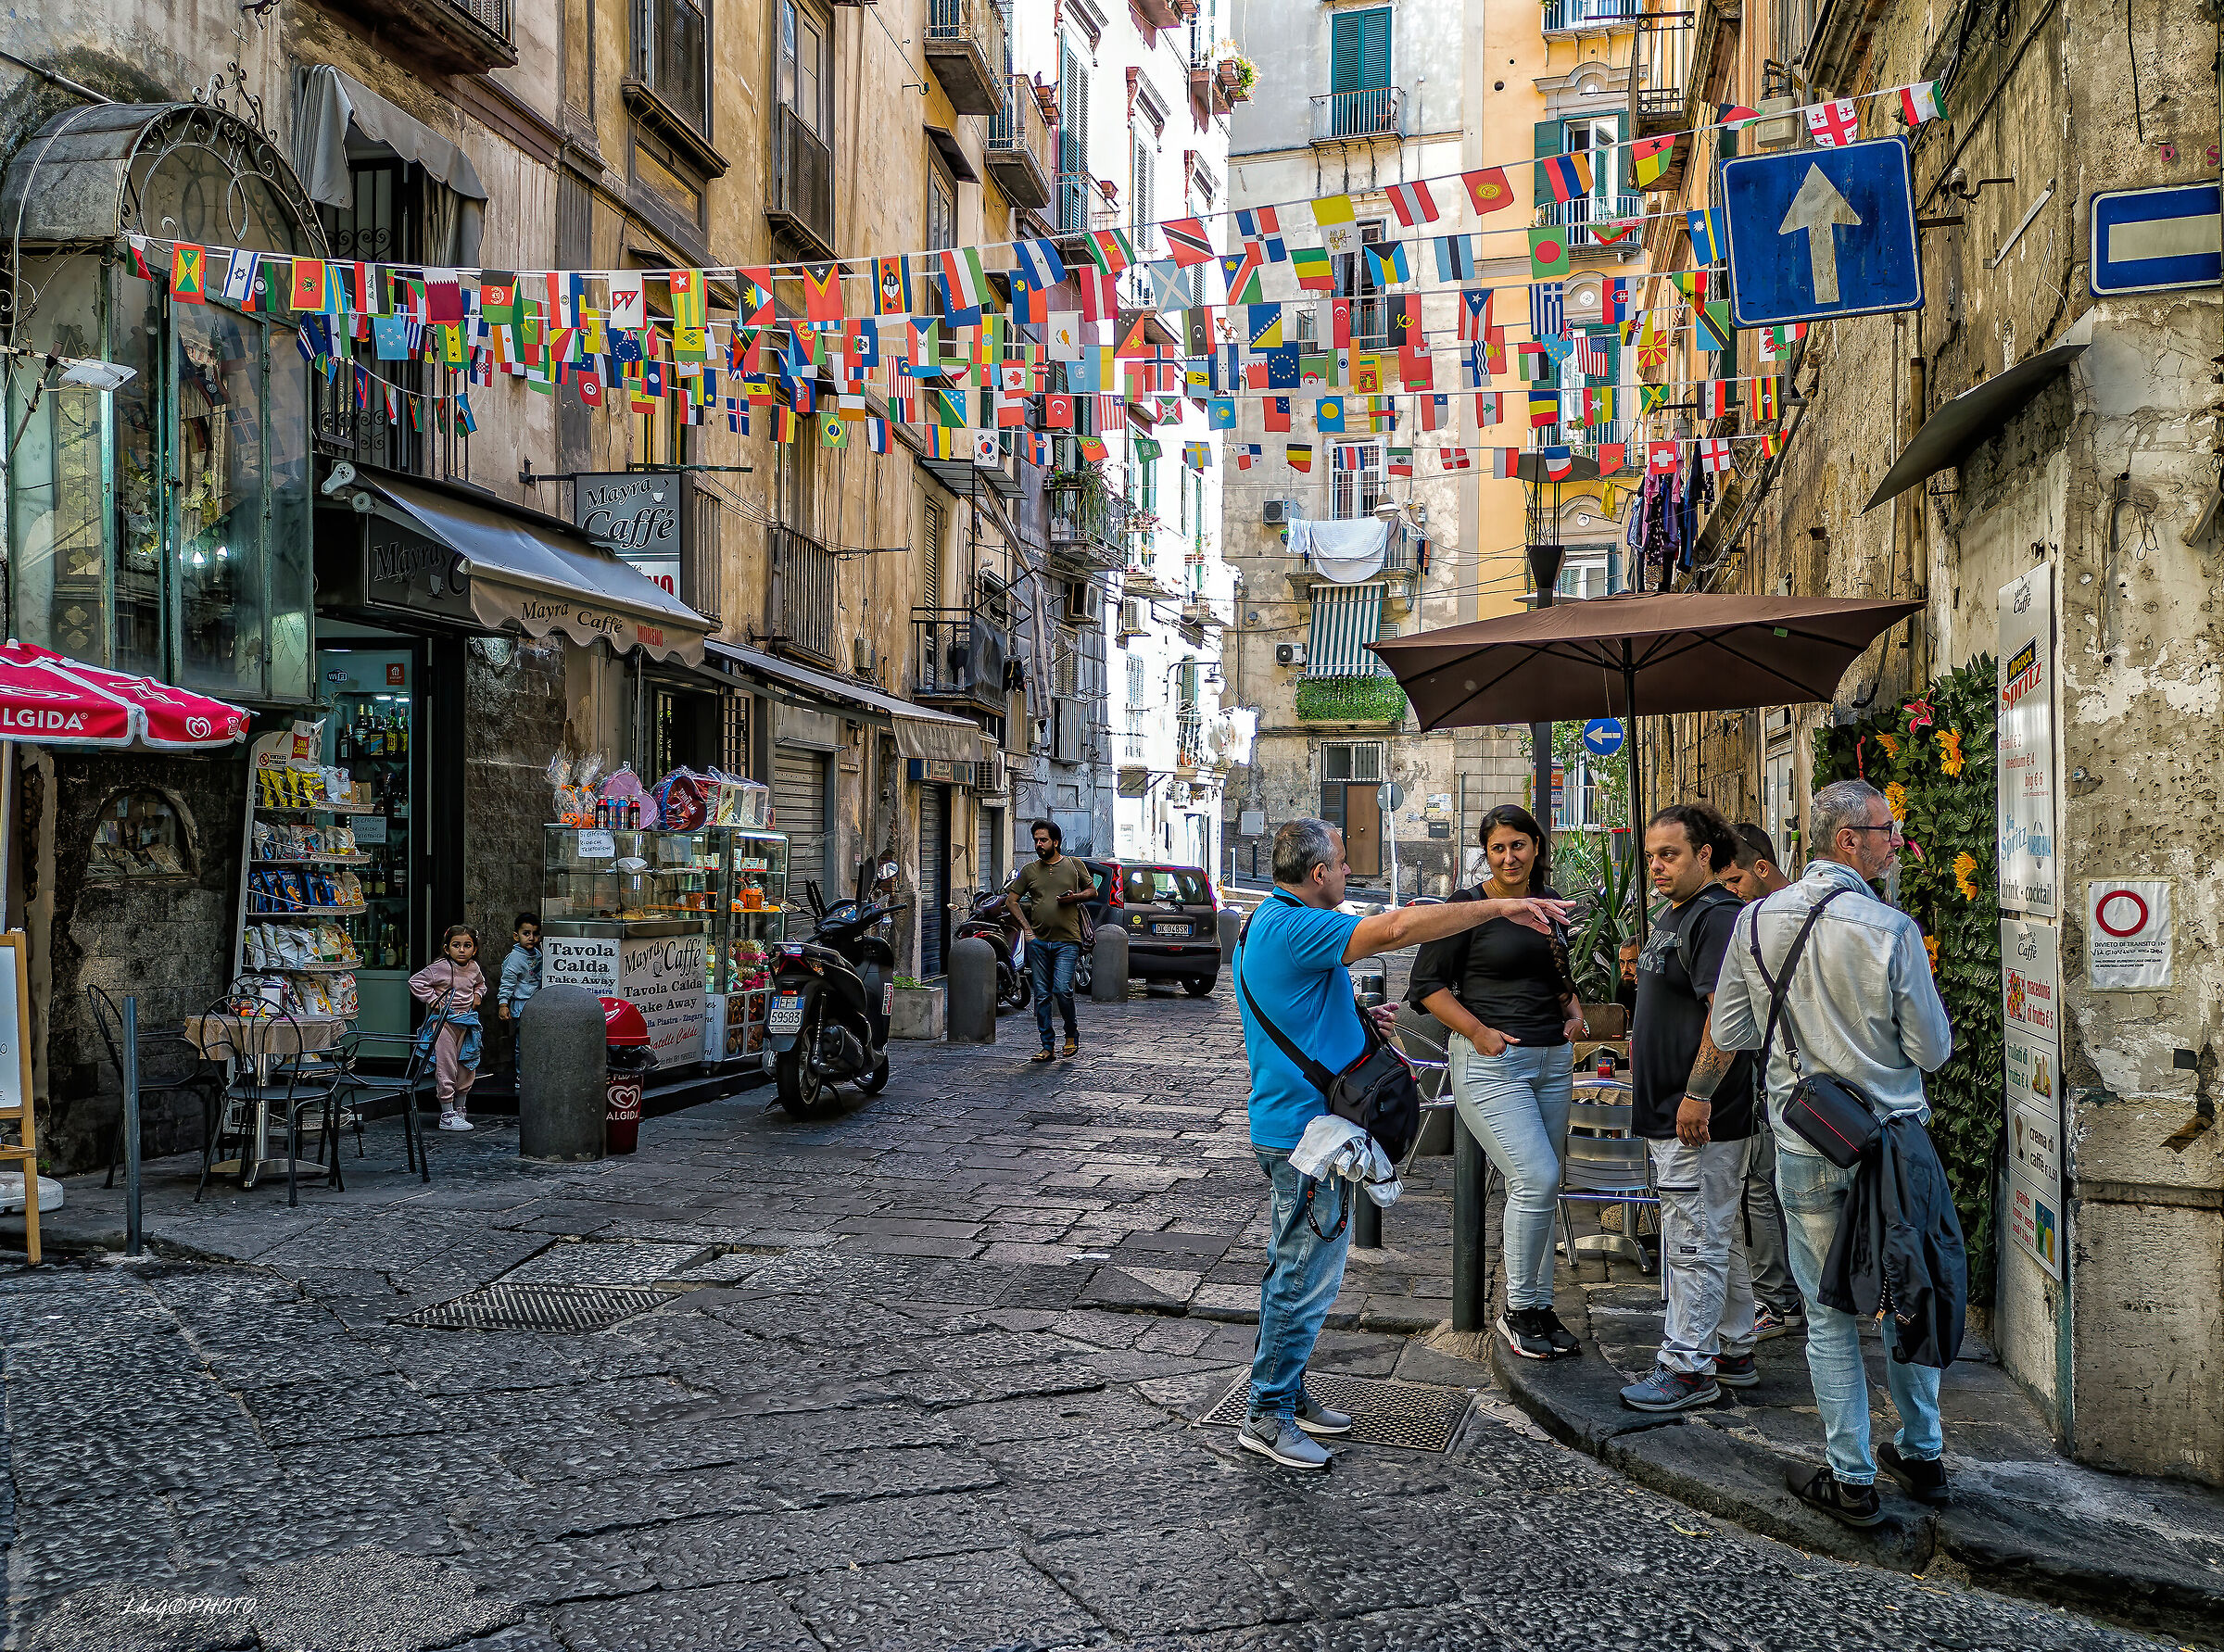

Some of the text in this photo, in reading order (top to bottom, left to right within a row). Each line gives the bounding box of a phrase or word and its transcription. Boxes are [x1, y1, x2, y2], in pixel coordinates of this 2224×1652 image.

[585, 478, 652, 510] Mayra
[521, 600, 569, 623] Mayra
[637, 624, 663, 648] MORENO
[2009, 648, 2034, 679] APEROL
[2002, 661, 2042, 713] Spritz
[3, 707, 84, 730] LGIDA
[2001, 826, 2028, 862] Spritz
[2002, 878, 2052, 906] drink cocktail
[549, 942, 615, 957] Tavola
[552, 958, 611, 973] Calda
[546, 975, 616, 988] Take Away
[624, 978, 703, 998] Tavola Calda
[665, 997, 697, 1011] Away
[771, 1011, 801, 1024] 59583
